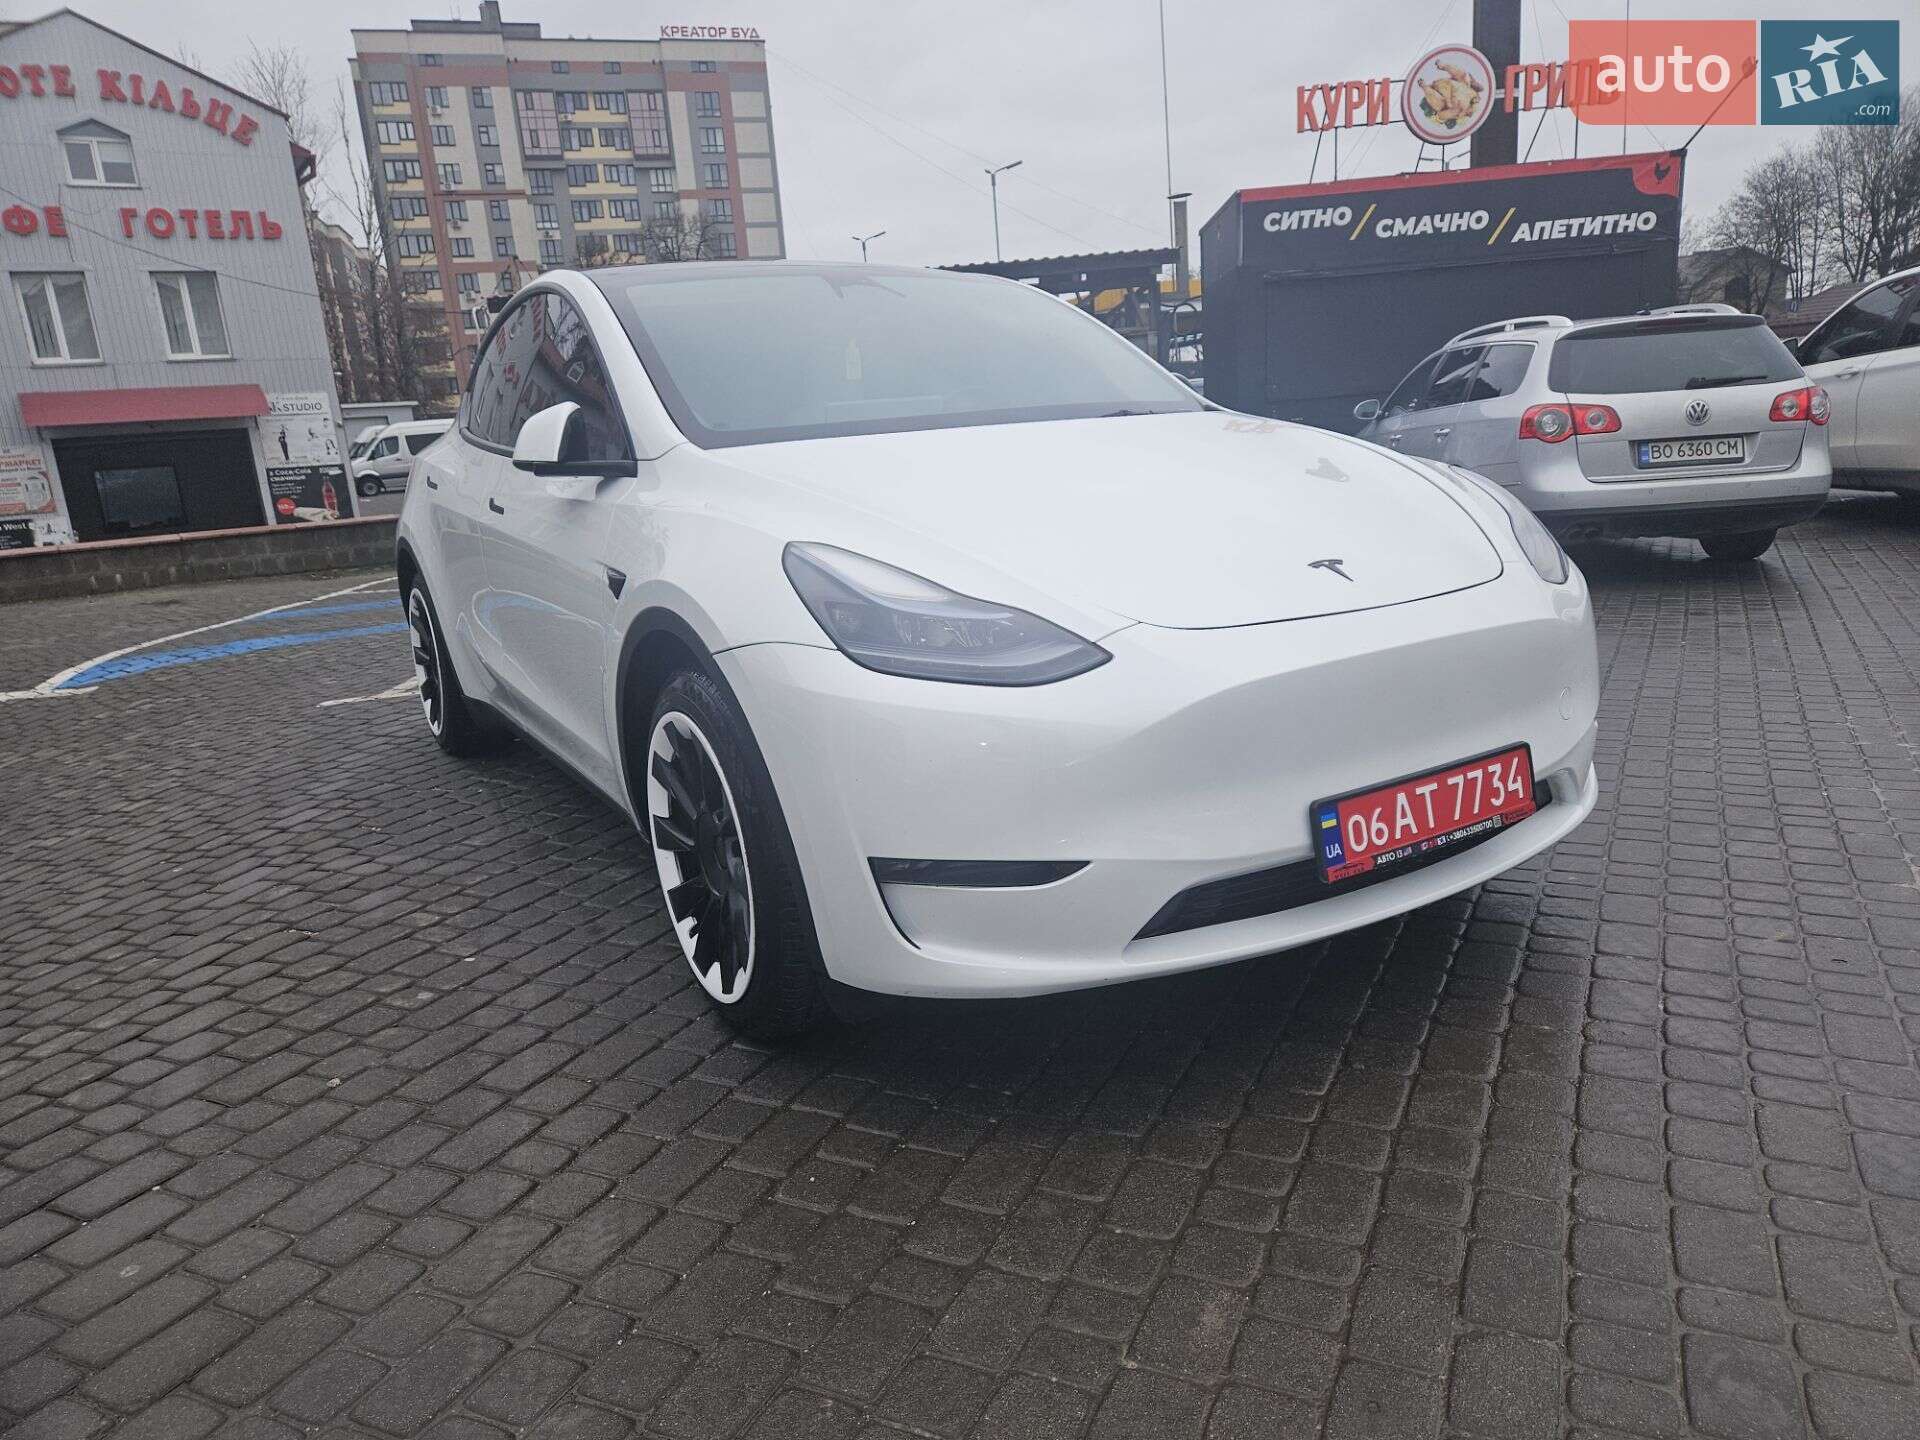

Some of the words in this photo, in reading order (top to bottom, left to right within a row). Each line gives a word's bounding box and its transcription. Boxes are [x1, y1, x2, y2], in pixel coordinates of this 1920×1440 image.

[660, 25, 727, 38] КРЕАТОР
[730, 27, 760, 39] БУД
[97, 68, 260, 146] КІЛЬЦЕ
[1296, 77, 1391, 133] КУРИ
[1, 205, 68, 237] ФЕ
[120, 207, 283, 240] ГОТЕЛЬ
[1263, 205, 1353, 233] СИТНО
[1375, 209, 1490, 239] СМАЧНО
[1510, 210, 1659, 243] АПЕТИТНО
[1651, 444, 1674, 459] BO
[1677, 441, 1713, 458] 6360
[1716, 439, 1739, 455] CM
[1325, 843, 1342, 859] UA
